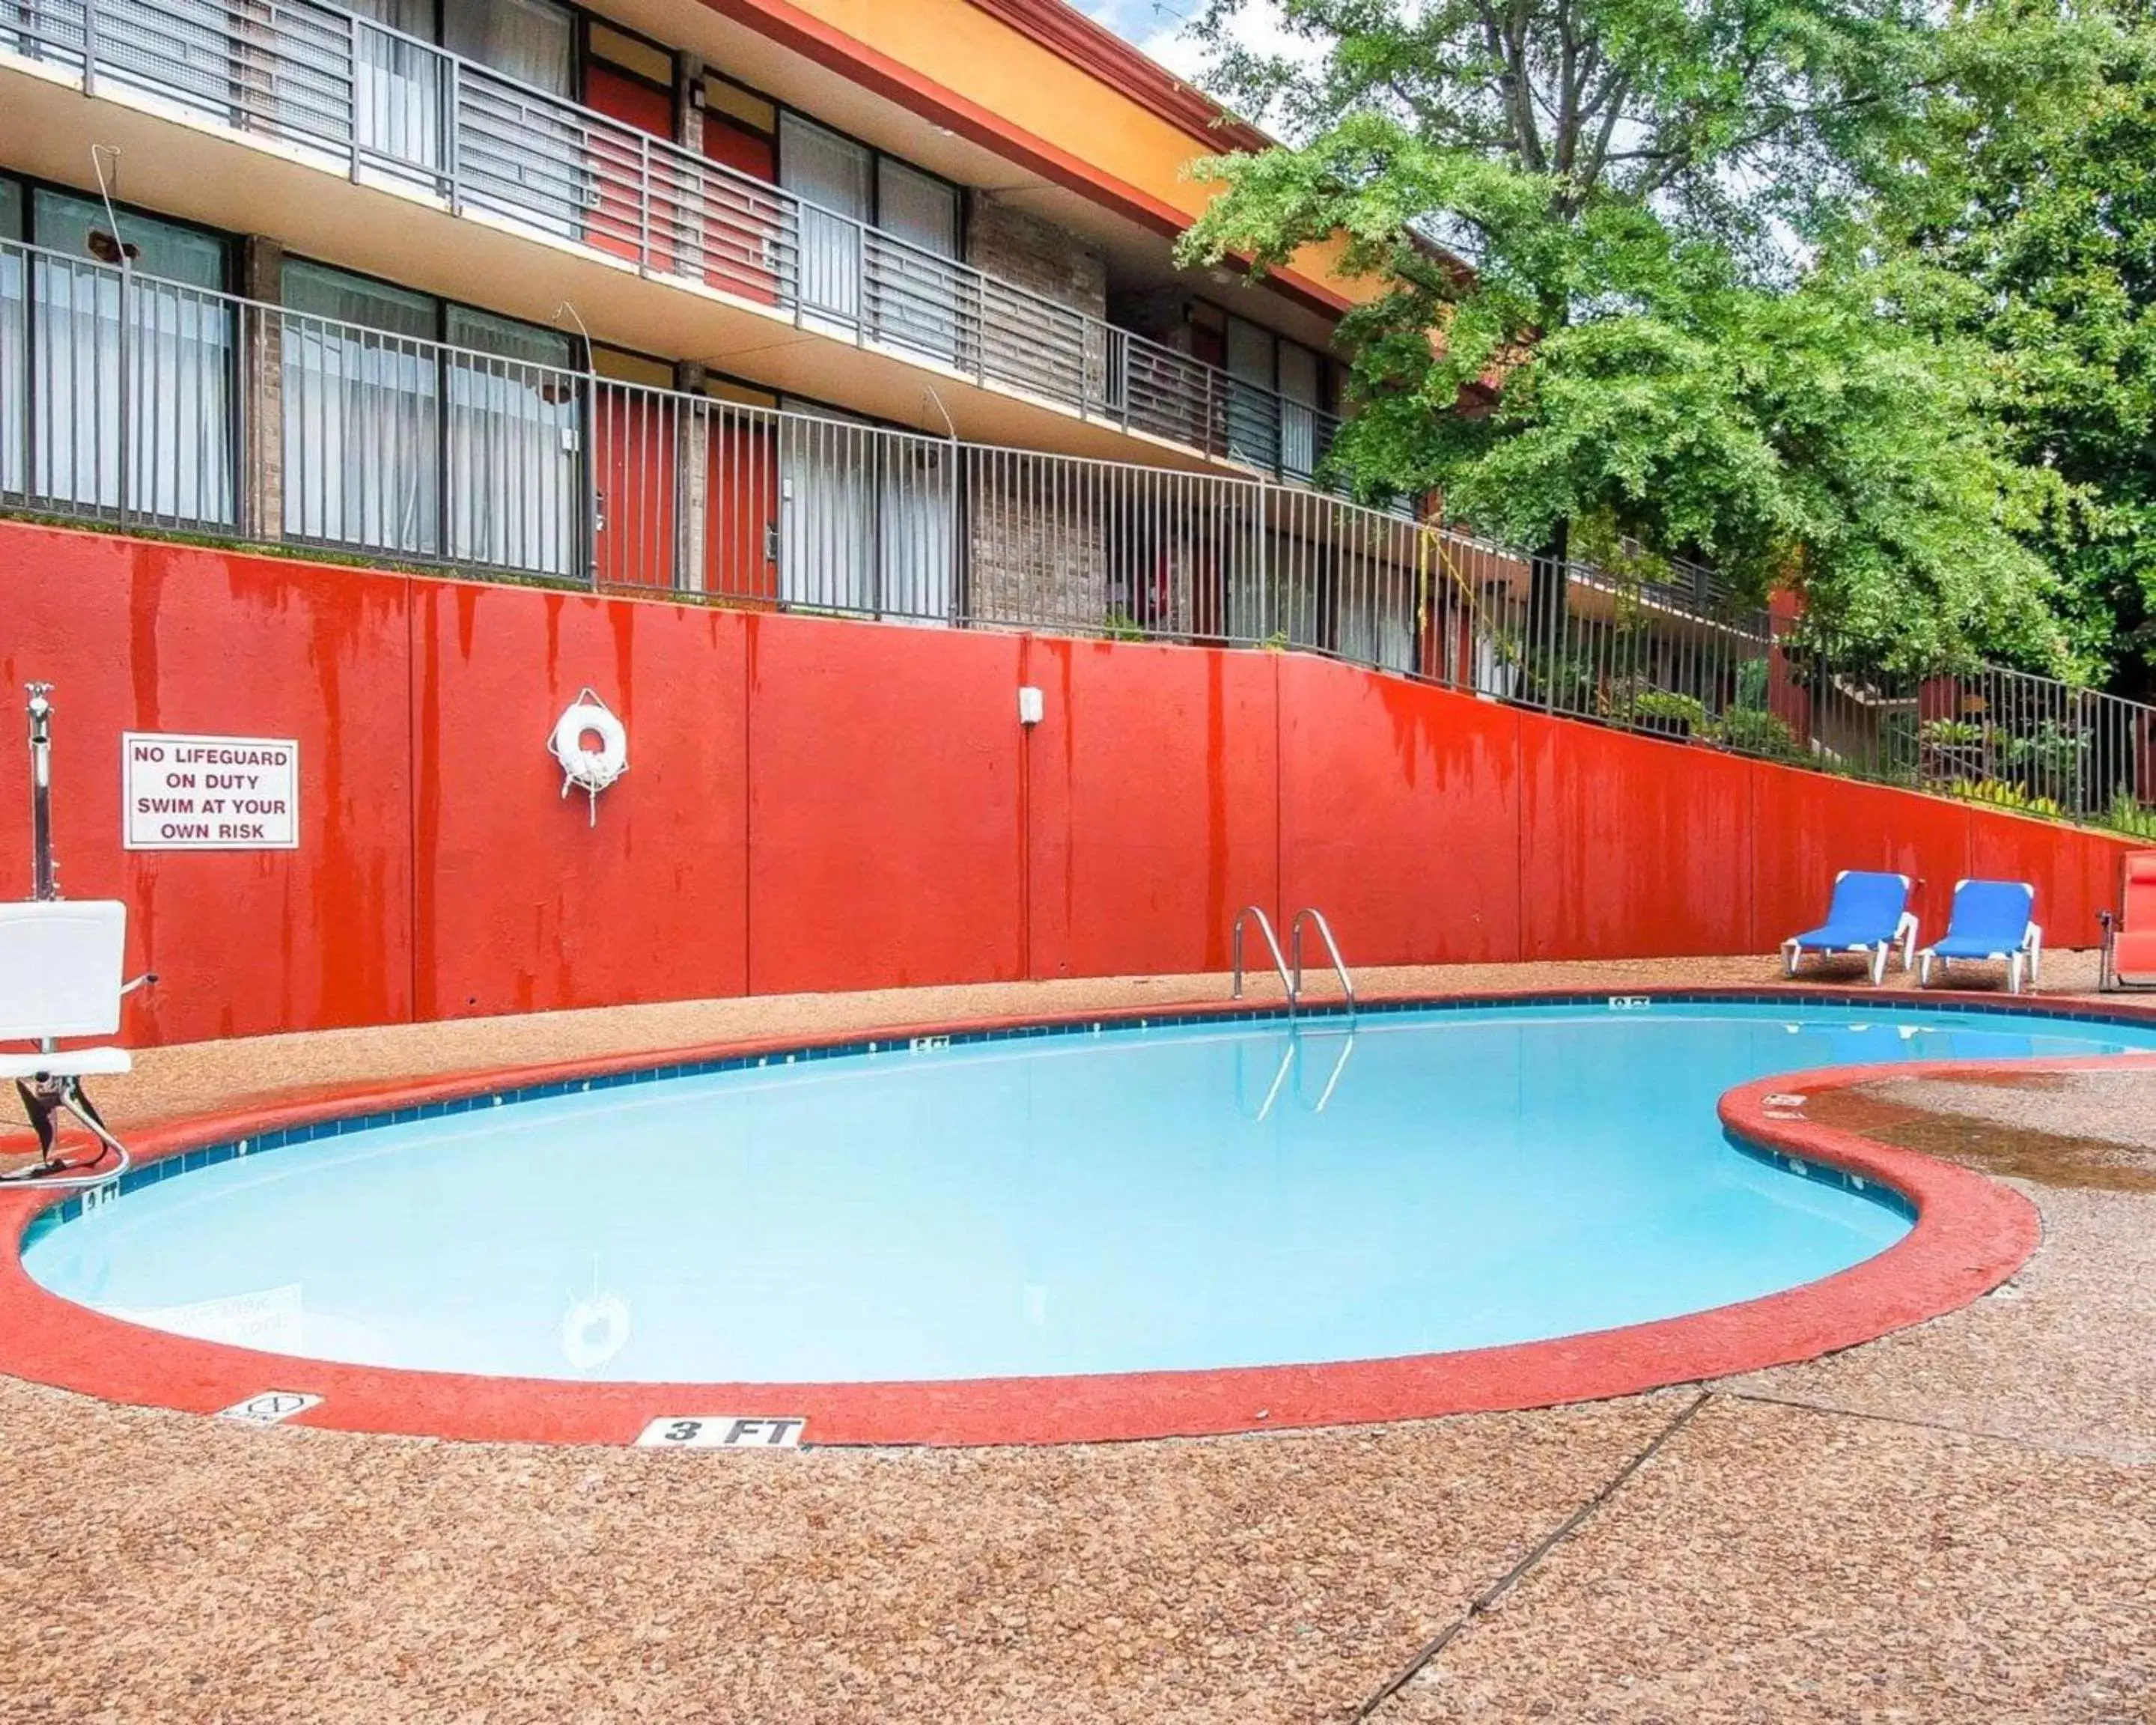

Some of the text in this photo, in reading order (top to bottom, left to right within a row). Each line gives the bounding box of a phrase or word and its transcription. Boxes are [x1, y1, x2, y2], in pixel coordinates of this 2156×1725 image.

[135, 747, 287, 766] NO LIFEGUARD
[166, 773, 258, 789] ON DUTY
[138, 798, 286, 814] SWIM AT YOUR
[161, 824, 264, 839] OWN RISK
[665, 1420, 803, 1444] 3 FT
